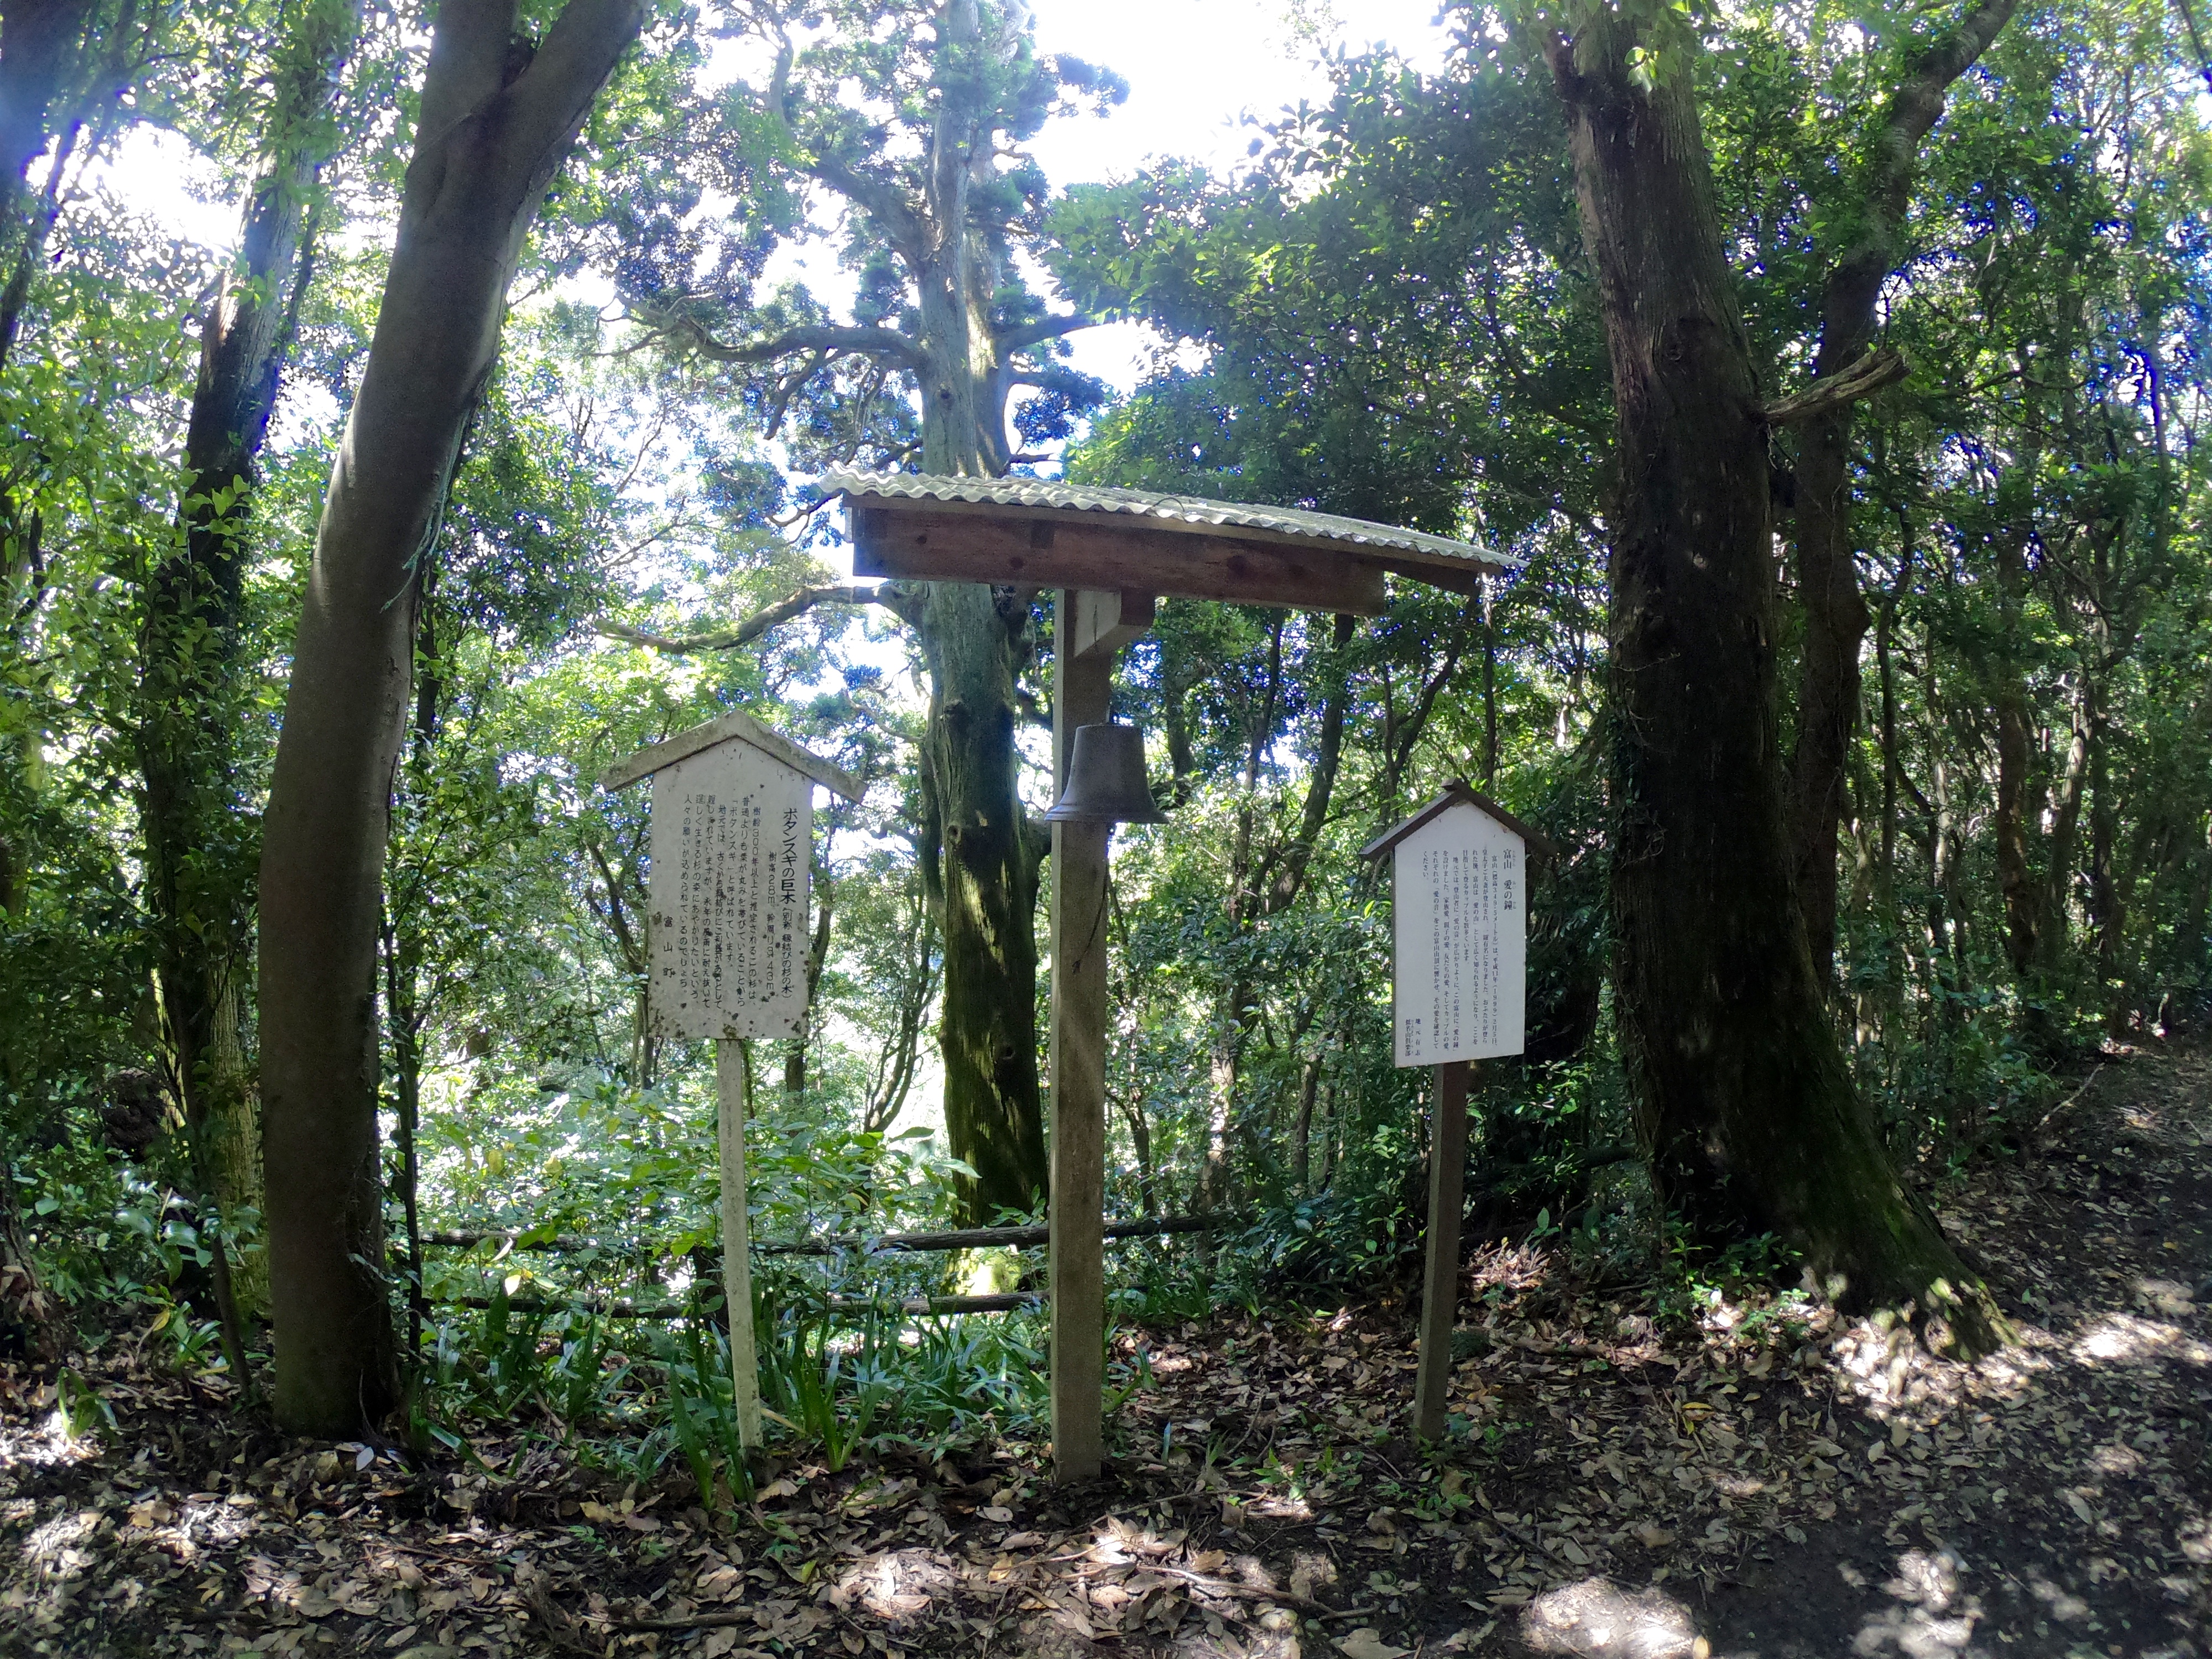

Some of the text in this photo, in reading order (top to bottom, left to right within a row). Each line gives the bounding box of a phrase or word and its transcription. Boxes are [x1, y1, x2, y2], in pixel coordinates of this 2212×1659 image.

[780, 807, 798, 904] ボタンスギの巨木
[1503, 849, 1512, 910] 富山 愛の鐘
